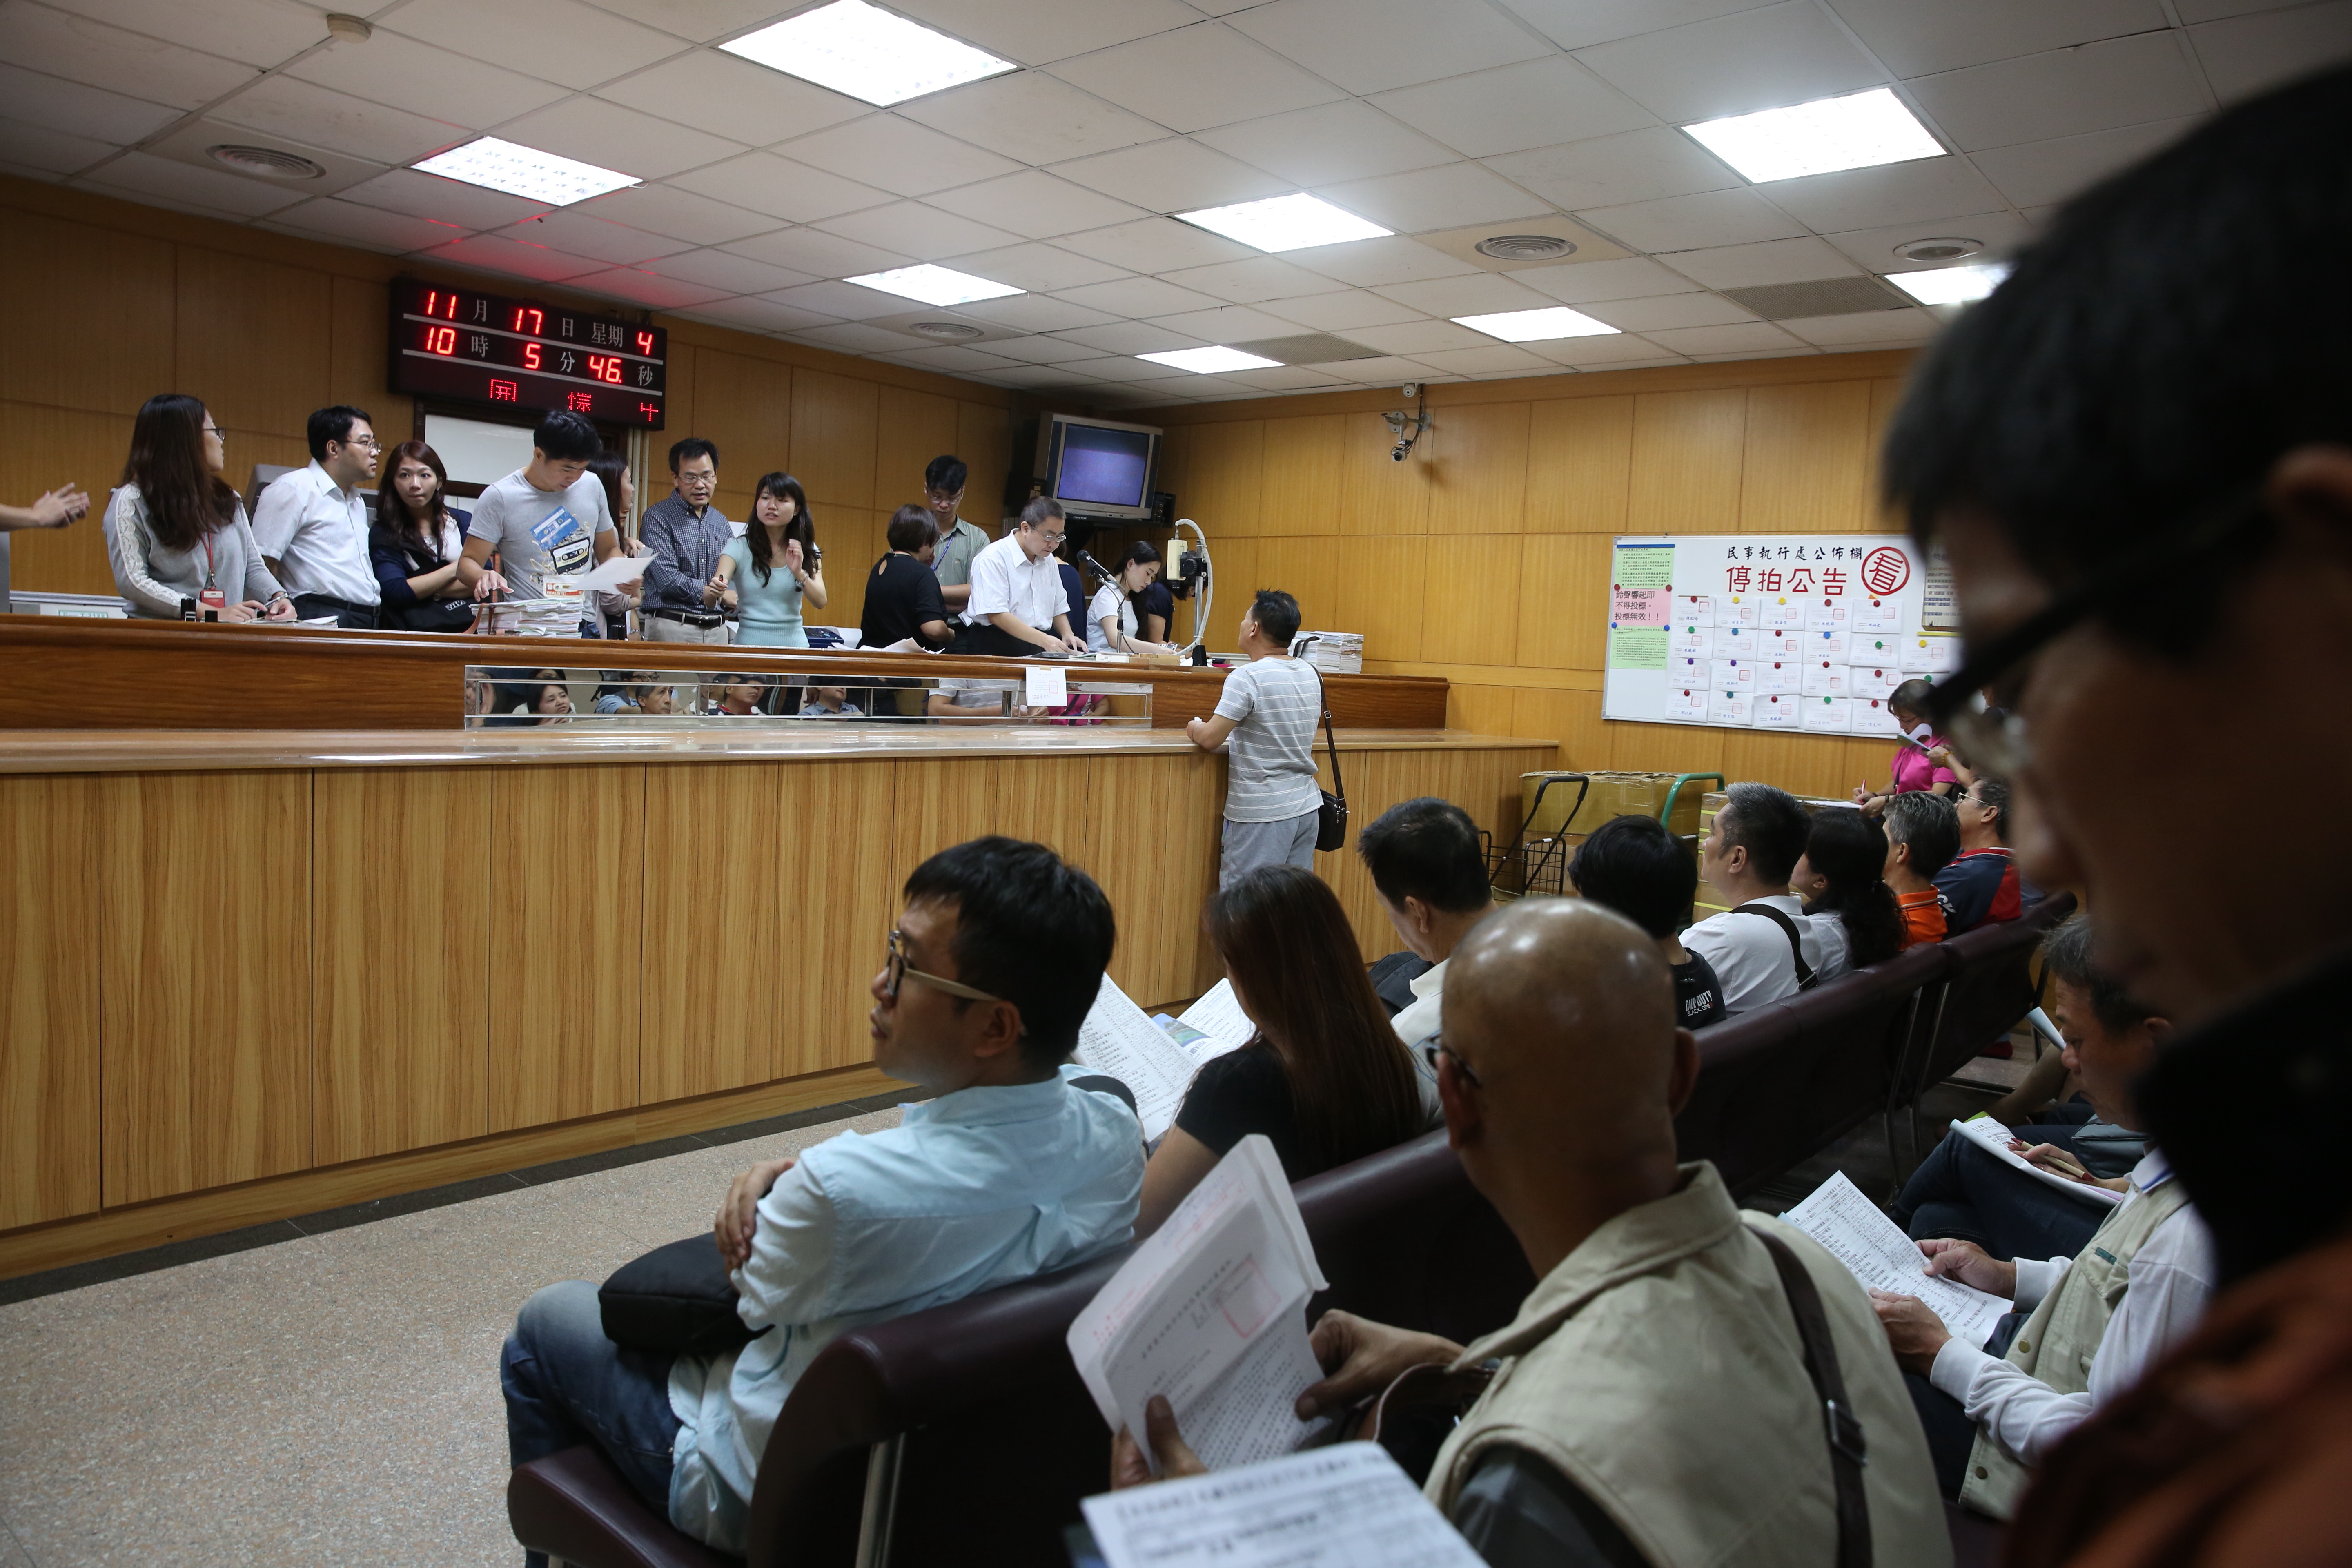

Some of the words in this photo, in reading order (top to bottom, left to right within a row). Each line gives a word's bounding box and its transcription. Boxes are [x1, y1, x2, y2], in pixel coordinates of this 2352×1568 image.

[428, 292, 456, 319] 11
[473, 299, 487, 322] 月
[516, 309, 542, 334] 17
[562, 317, 574, 337] 日
[591, 322, 624, 347] 星期
[637, 332, 653, 355] 4
[427, 327, 455, 354] 10
[471, 335, 488, 358] 時
[525, 343, 541, 369] 5
[560, 351, 575, 372] 分
[637, 365, 653, 386] 秒
[1726, 546, 1863, 561] 民事執行處公佈欄
[1726, 565, 1847, 596] 停拍公告
[1869, 552, 1904, 591] 看
[1615, 590, 1655, 599] 鈴聲響起即
[1615, 601, 1652, 610] 不得投標。
[1685, 997, 1696, 1012] CALL
[1696, 990, 1712, 1007] DUTY
[1687, 1007, 1702, 1016] BLACK
